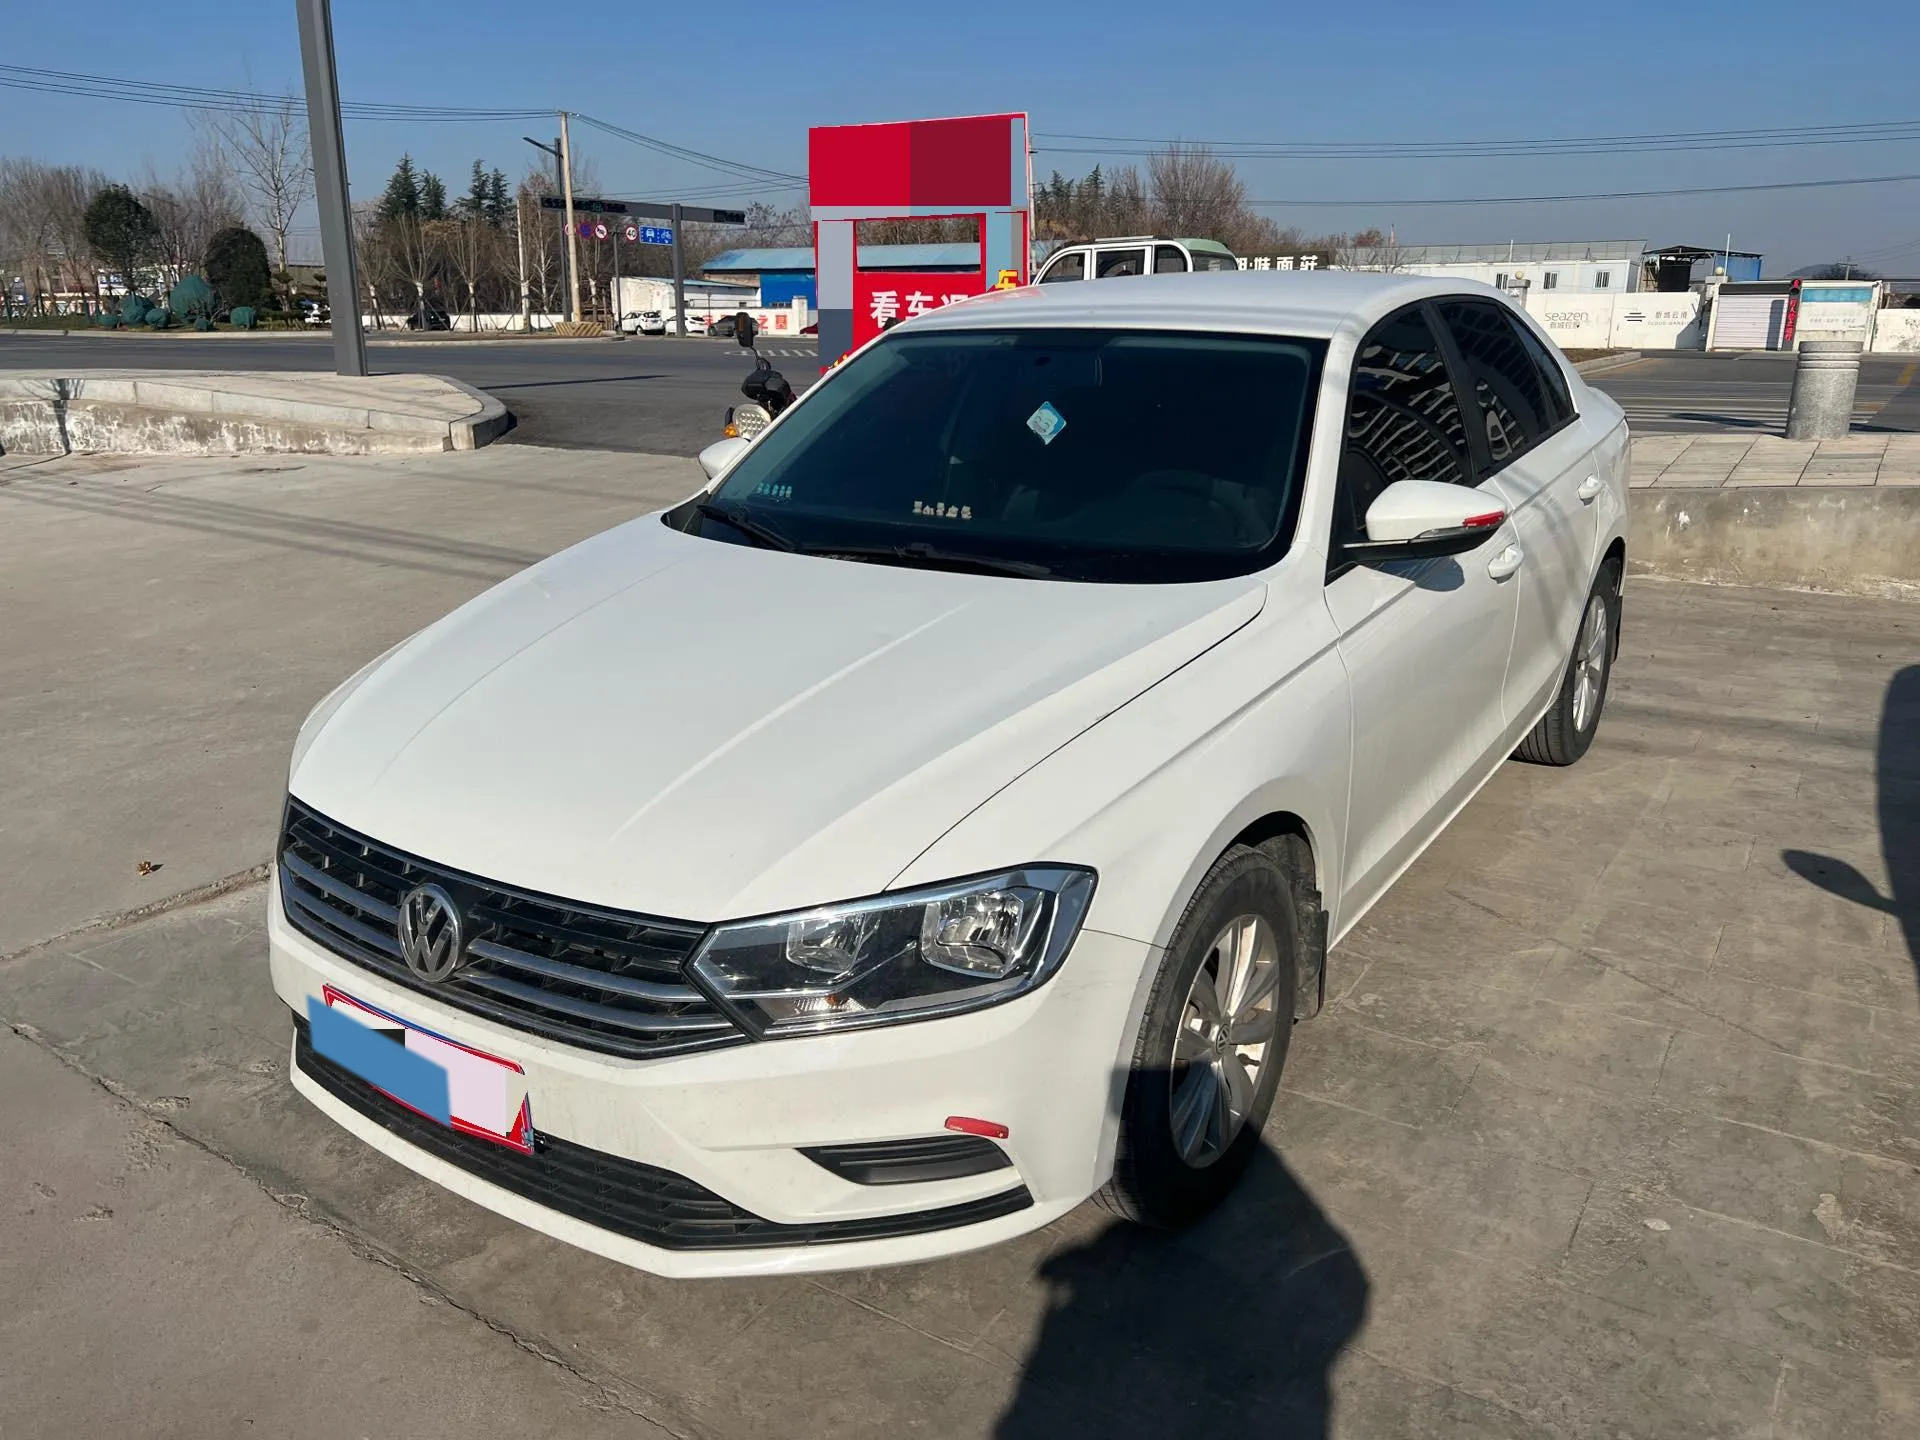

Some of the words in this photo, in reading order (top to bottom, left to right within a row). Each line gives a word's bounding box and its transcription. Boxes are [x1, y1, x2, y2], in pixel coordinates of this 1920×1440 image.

[627, 228, 638, 240] 40
[870, 290, 970, 328] 看车
[1544, 311, 1589, 322] seazen
